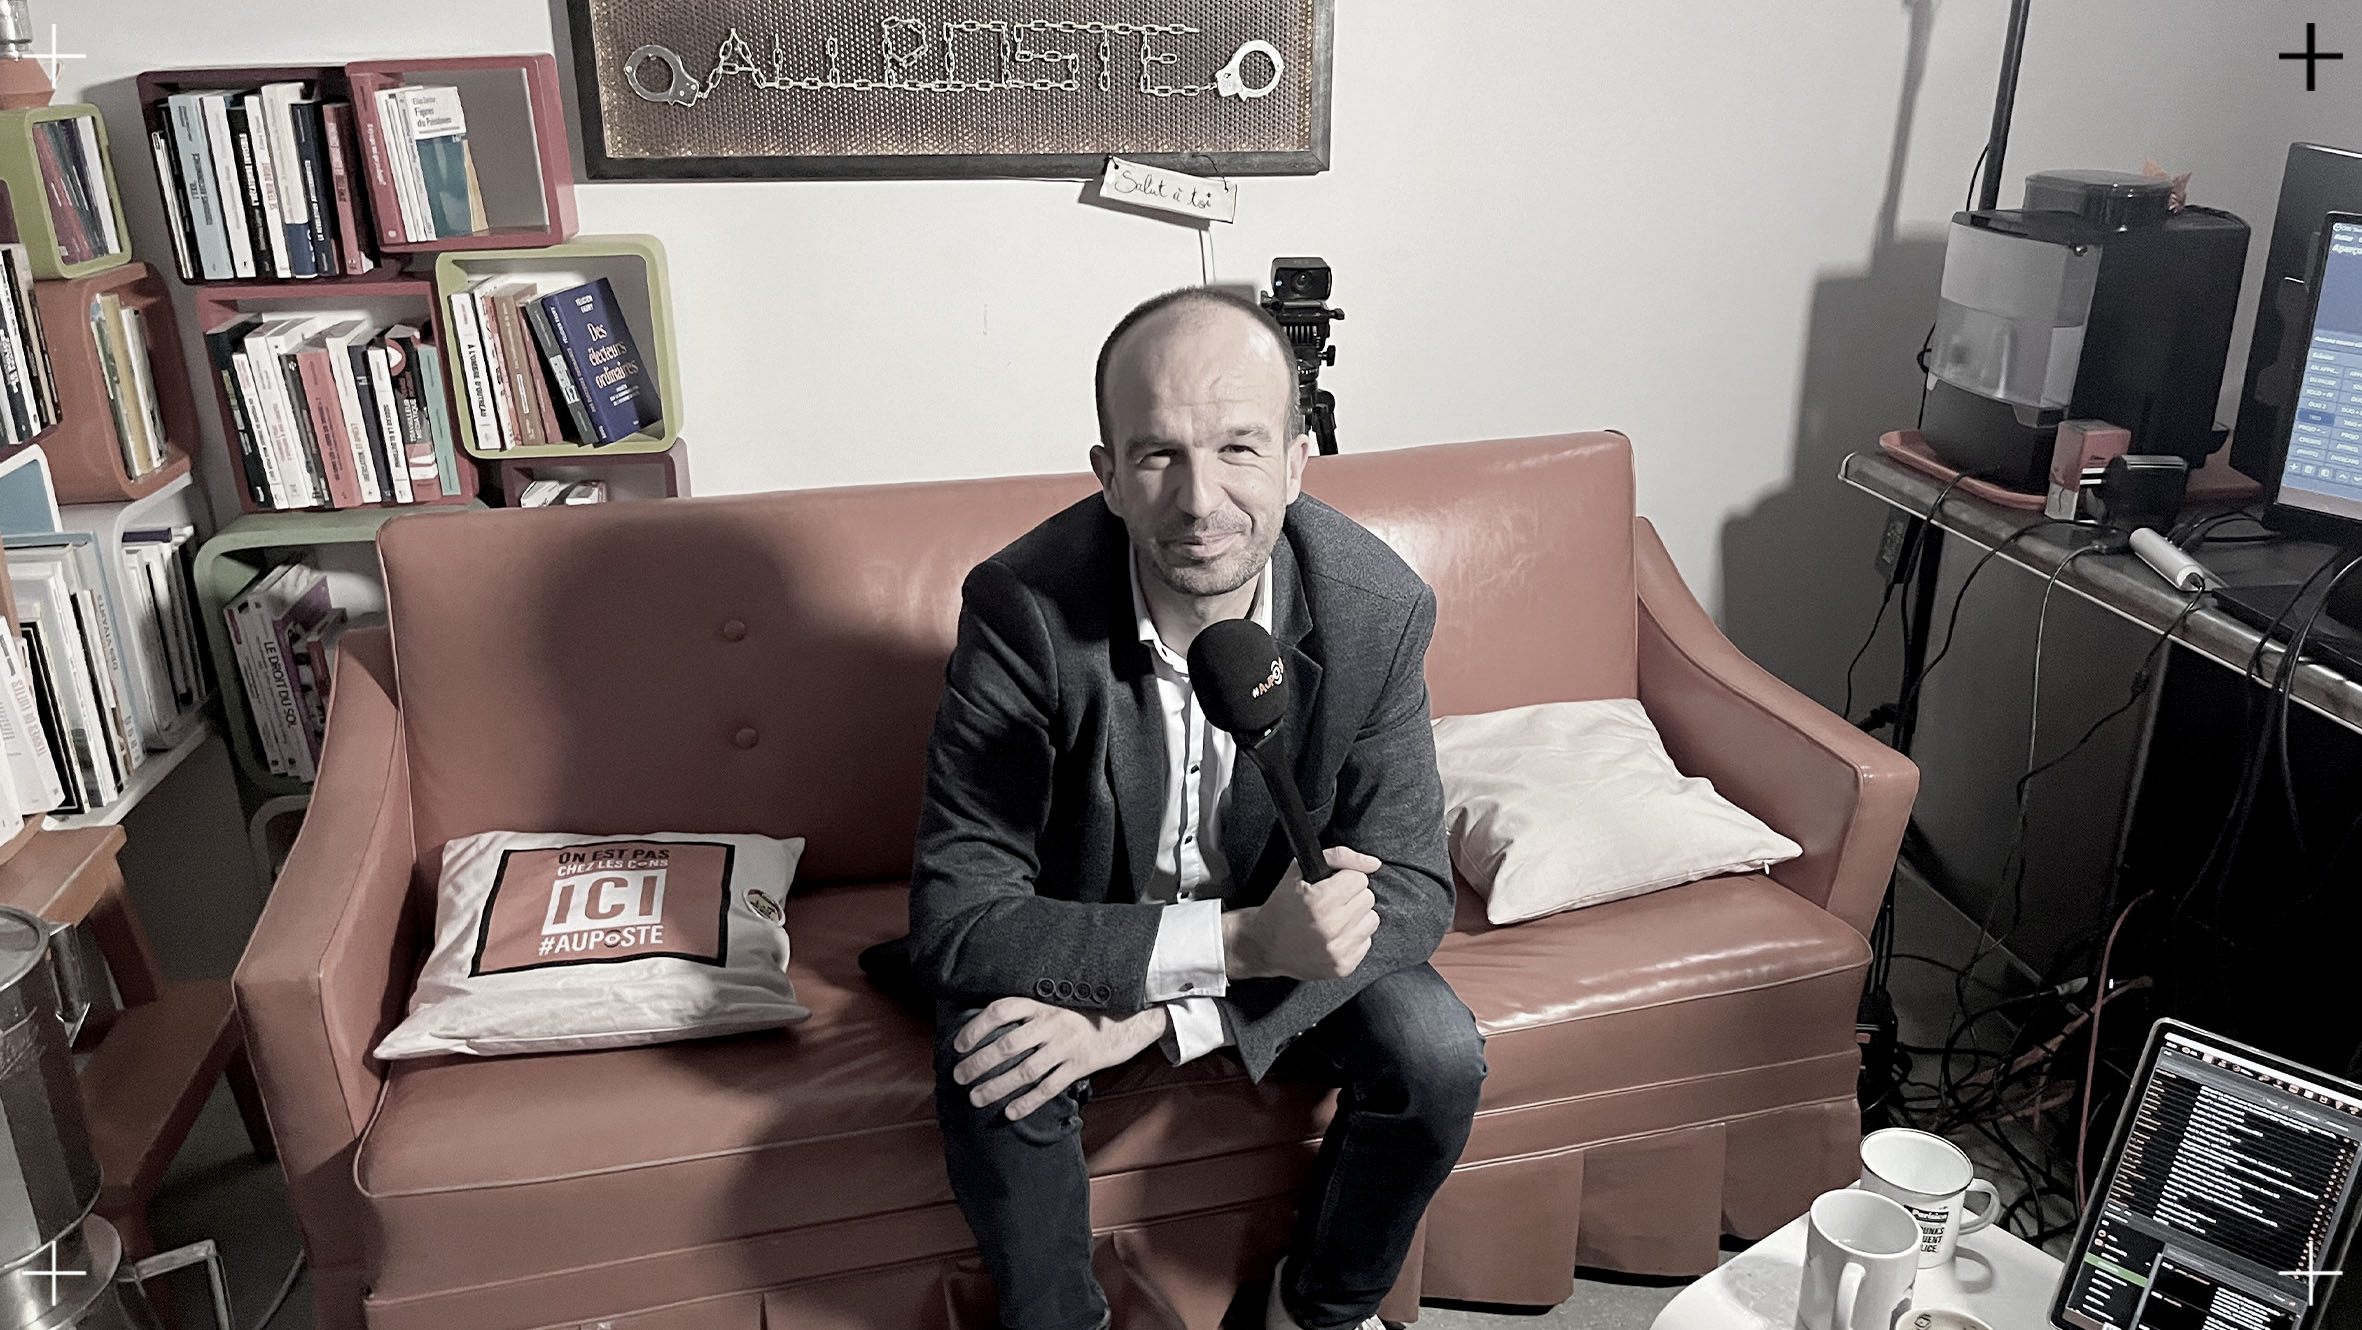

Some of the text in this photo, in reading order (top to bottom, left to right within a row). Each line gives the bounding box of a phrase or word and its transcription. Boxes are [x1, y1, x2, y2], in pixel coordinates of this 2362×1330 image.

[882, 16, 1200, 95] POSTE
[1115, 170, 1211, 208] Salut à toi
[586, 322, 607, 342] Des
[588, 340, 627, 367] électeurs
[596, 359, 639, 390] ordinaires
[96, 593, 119, 670] DES VIVANTS
[11, 678, 31, 712] LUTTES
[263, 639, 298, 728] LE DROIT DU SOL
[27, 723, 47, 757] TERRES
[557, 862, 594, 876] CHEZ
[598, 860, 623, 869] LES
[558, 848, 670, 864] ON EST PAS
[552, 876, 658, 925] ICI
[538, 925, 664, 956] #AUPOSTE
[1920, 1226, 1944, 1234] UNKS
[1922, 1236, 1942, 1244] UENT
[1920, 1244, 1938, 1253] LICE
